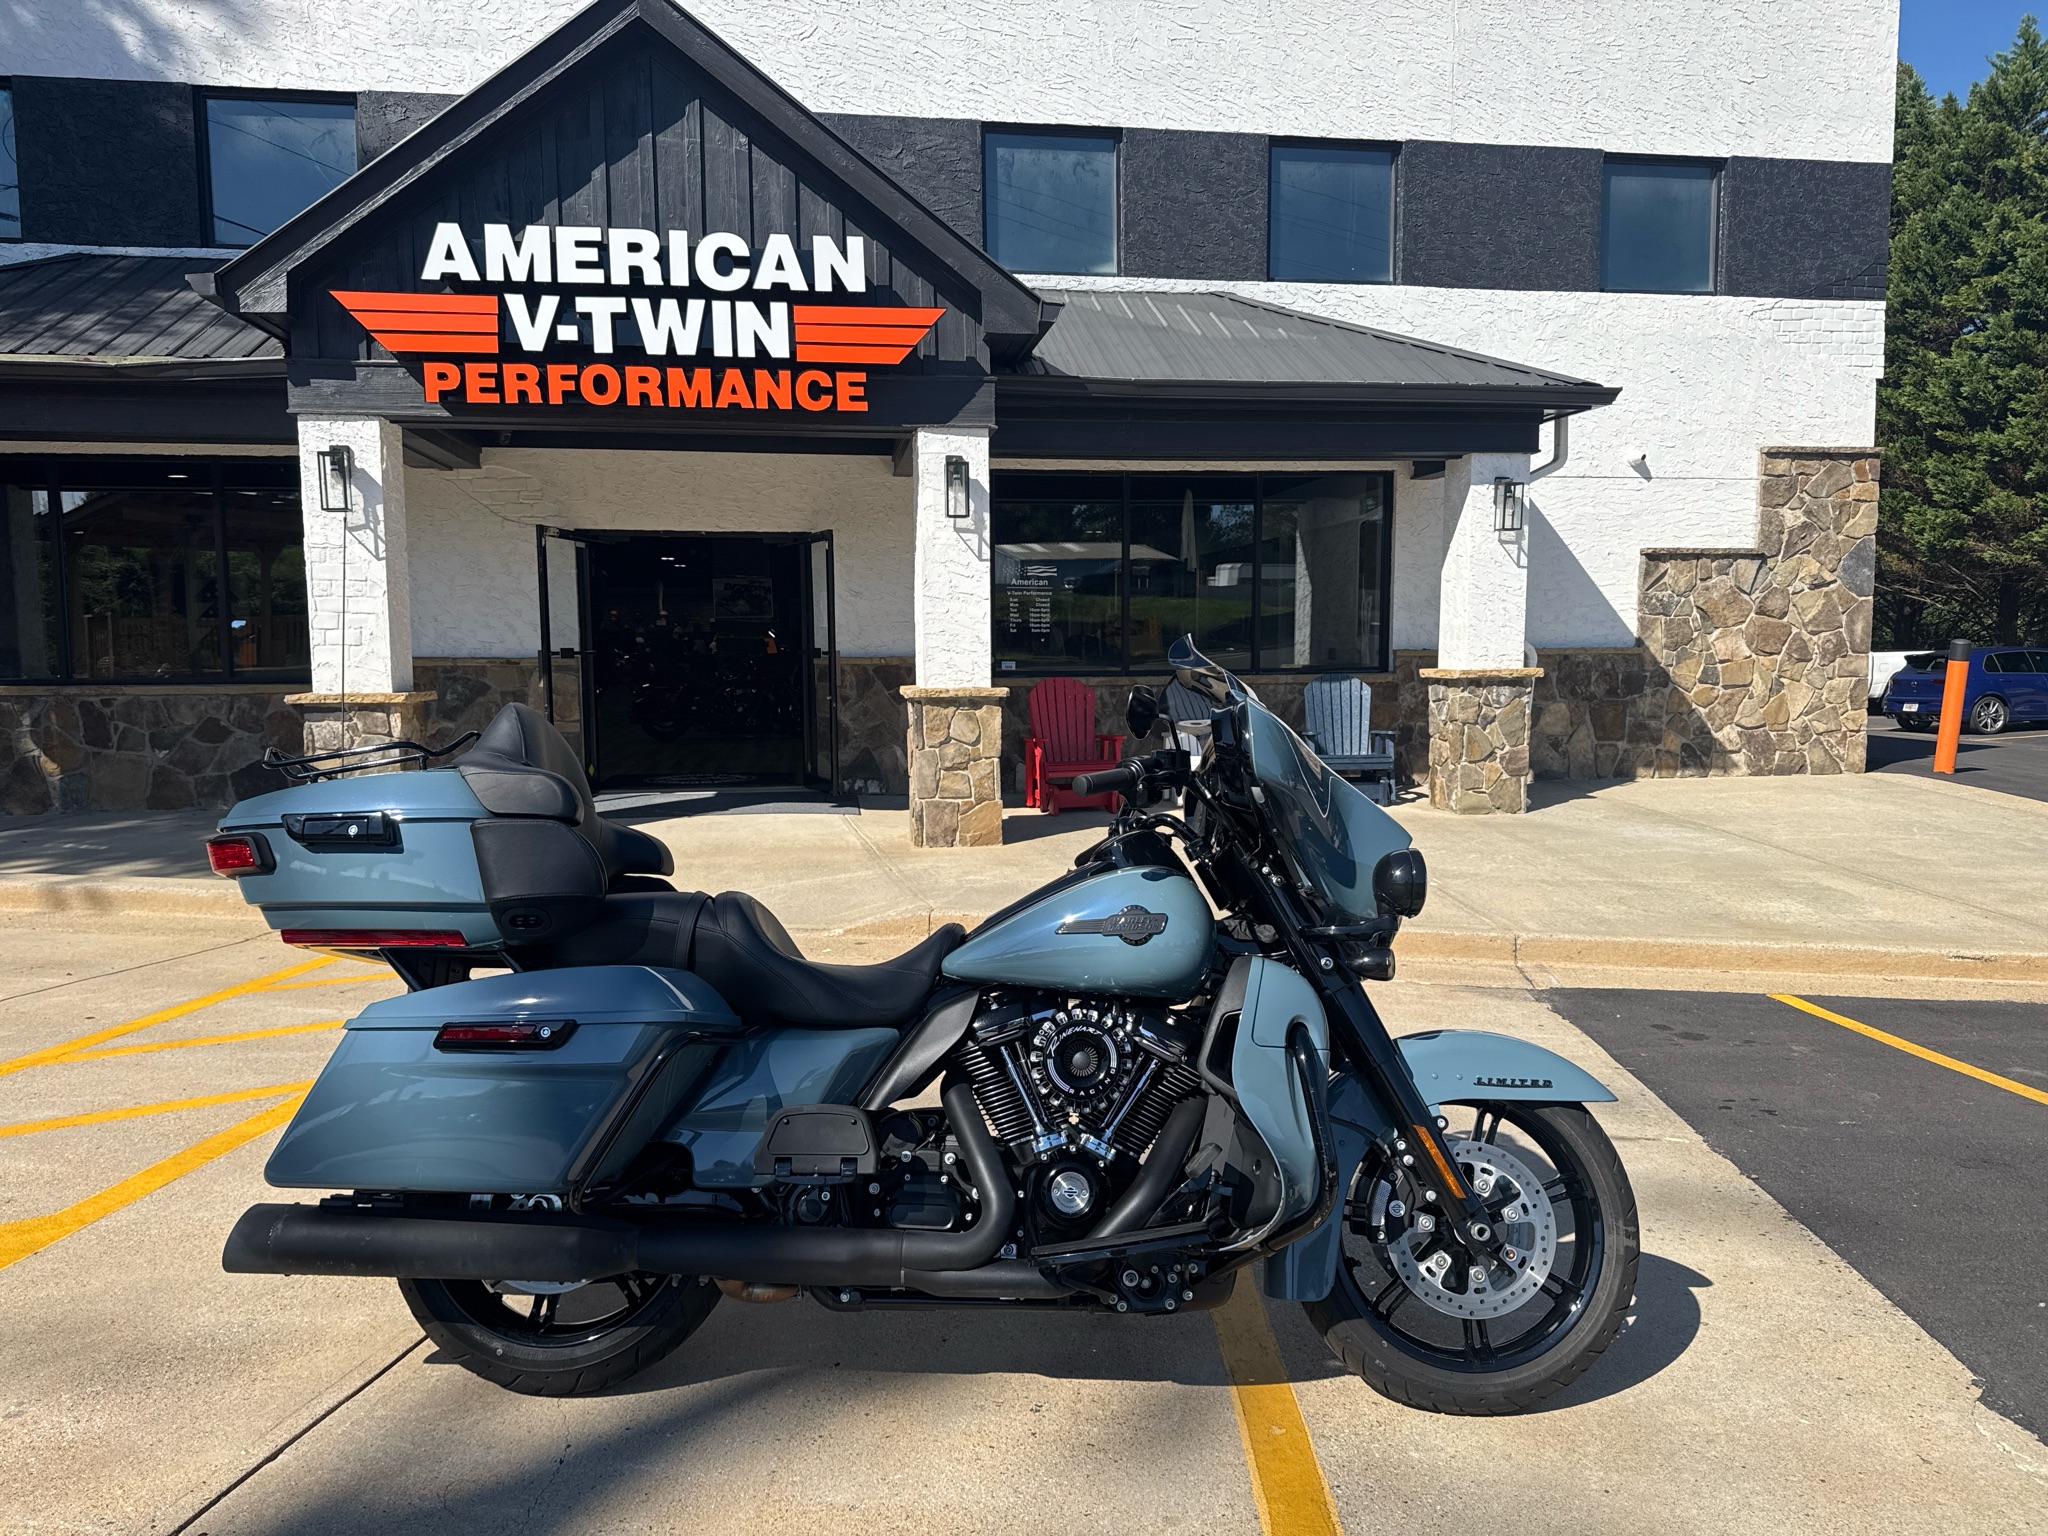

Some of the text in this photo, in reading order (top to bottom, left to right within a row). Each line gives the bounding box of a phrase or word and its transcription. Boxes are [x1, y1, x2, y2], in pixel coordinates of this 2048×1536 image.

[421, 222, 867, 293] AMERICAN
[504, 294, 791, 359] V-TWIN
[423, 362, 869, 412] PERFORMANCE
[1011, 578, 1049, 586] American
[1107, 923, 1160, 932] DAVIDSON
[1046, 1025, 1103, 1057] RINEHART
[1068, 1068, 1116, 1096] RACING
[1475, 1076, 1554, 1088] LIMITED
